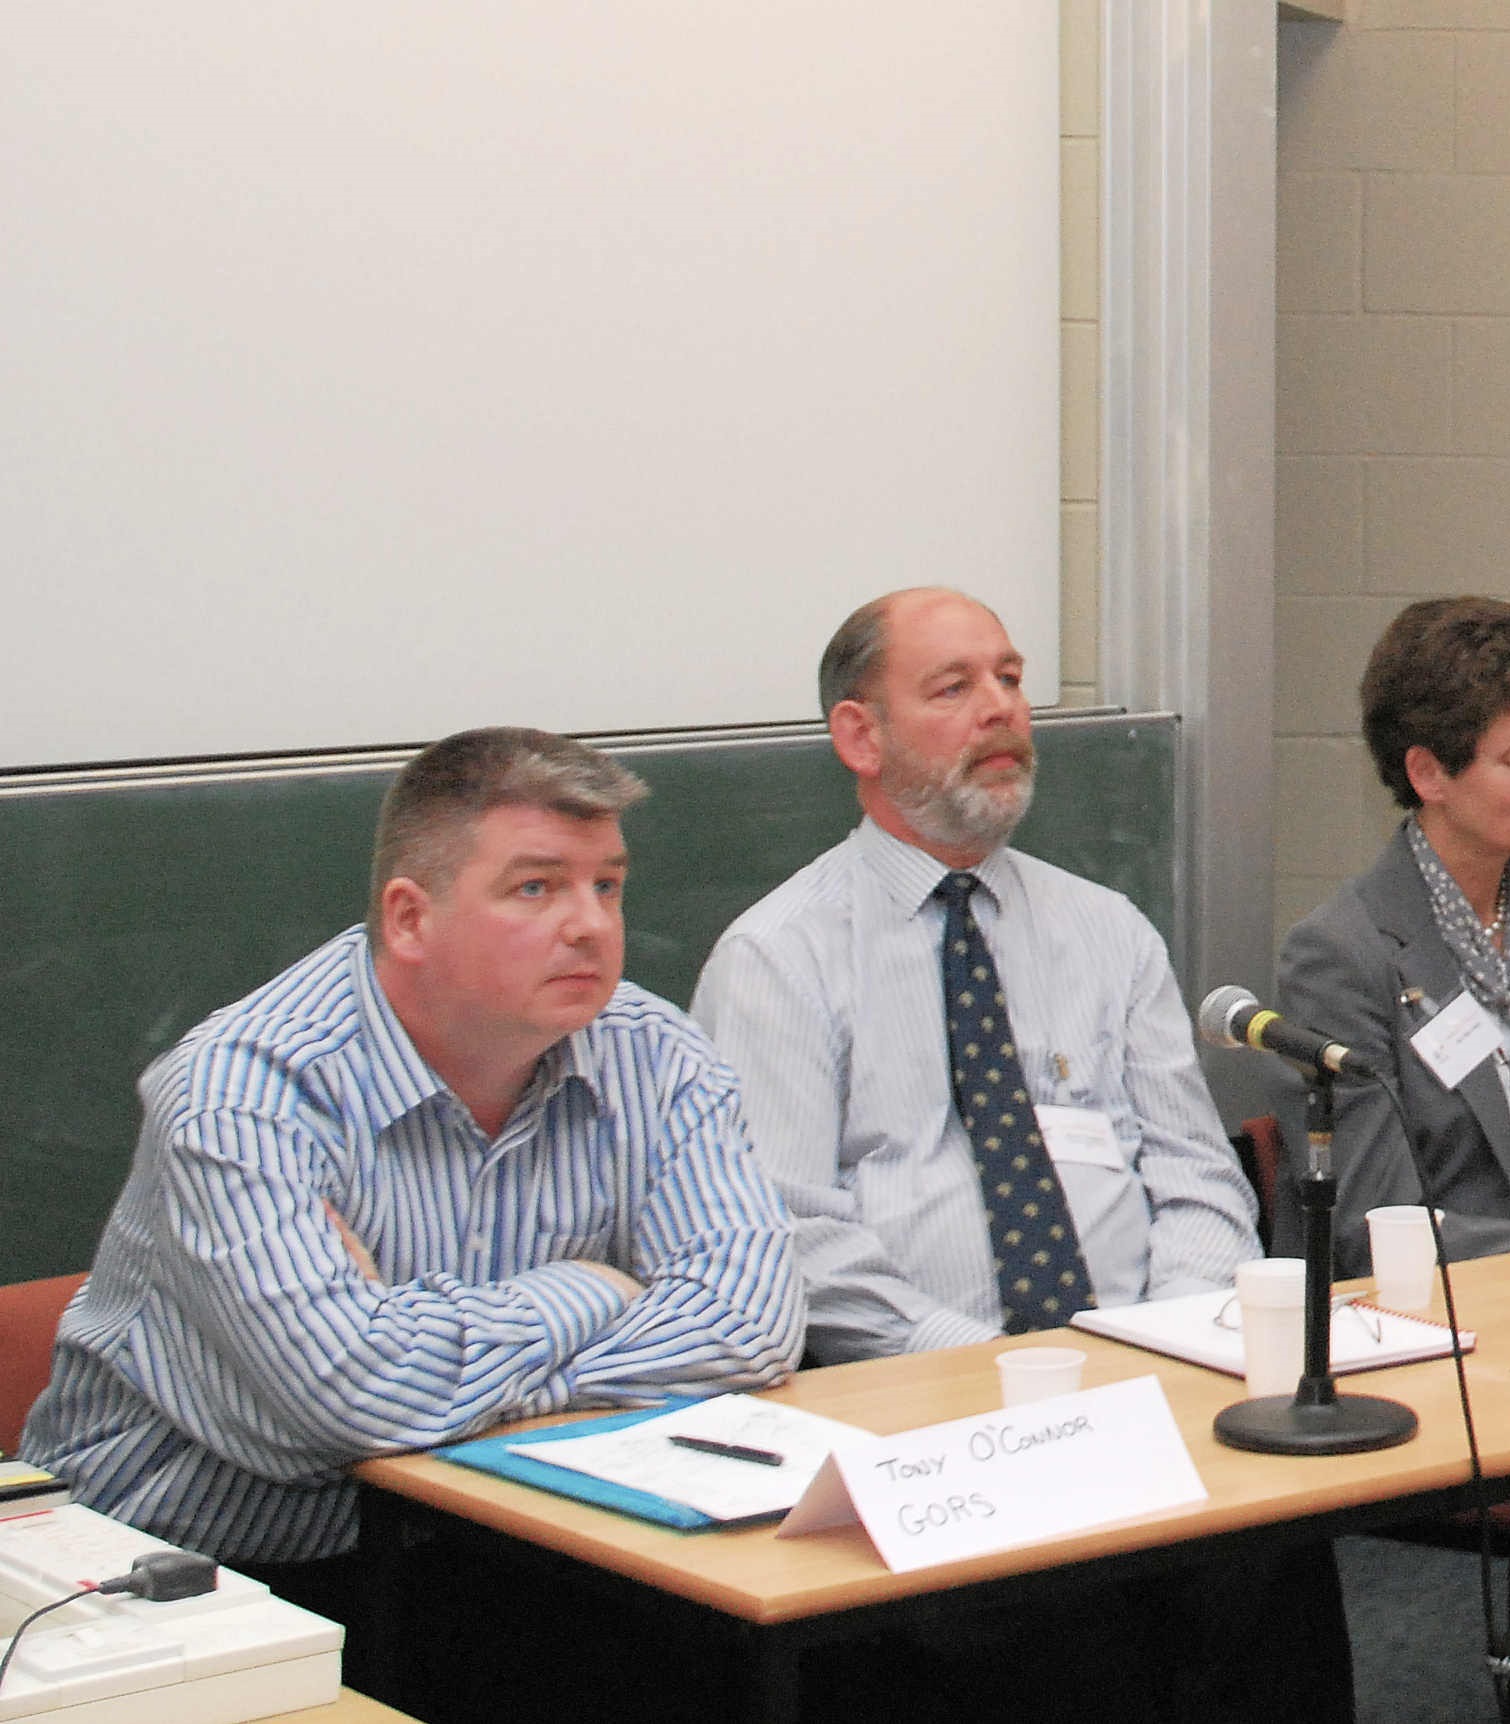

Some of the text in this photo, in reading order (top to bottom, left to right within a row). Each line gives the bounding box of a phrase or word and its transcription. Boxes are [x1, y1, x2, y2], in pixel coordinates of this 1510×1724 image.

[874, 1414, 1095, 1483] TONY O'CONNOR
[897, 1491, 997, 1537] GORS
